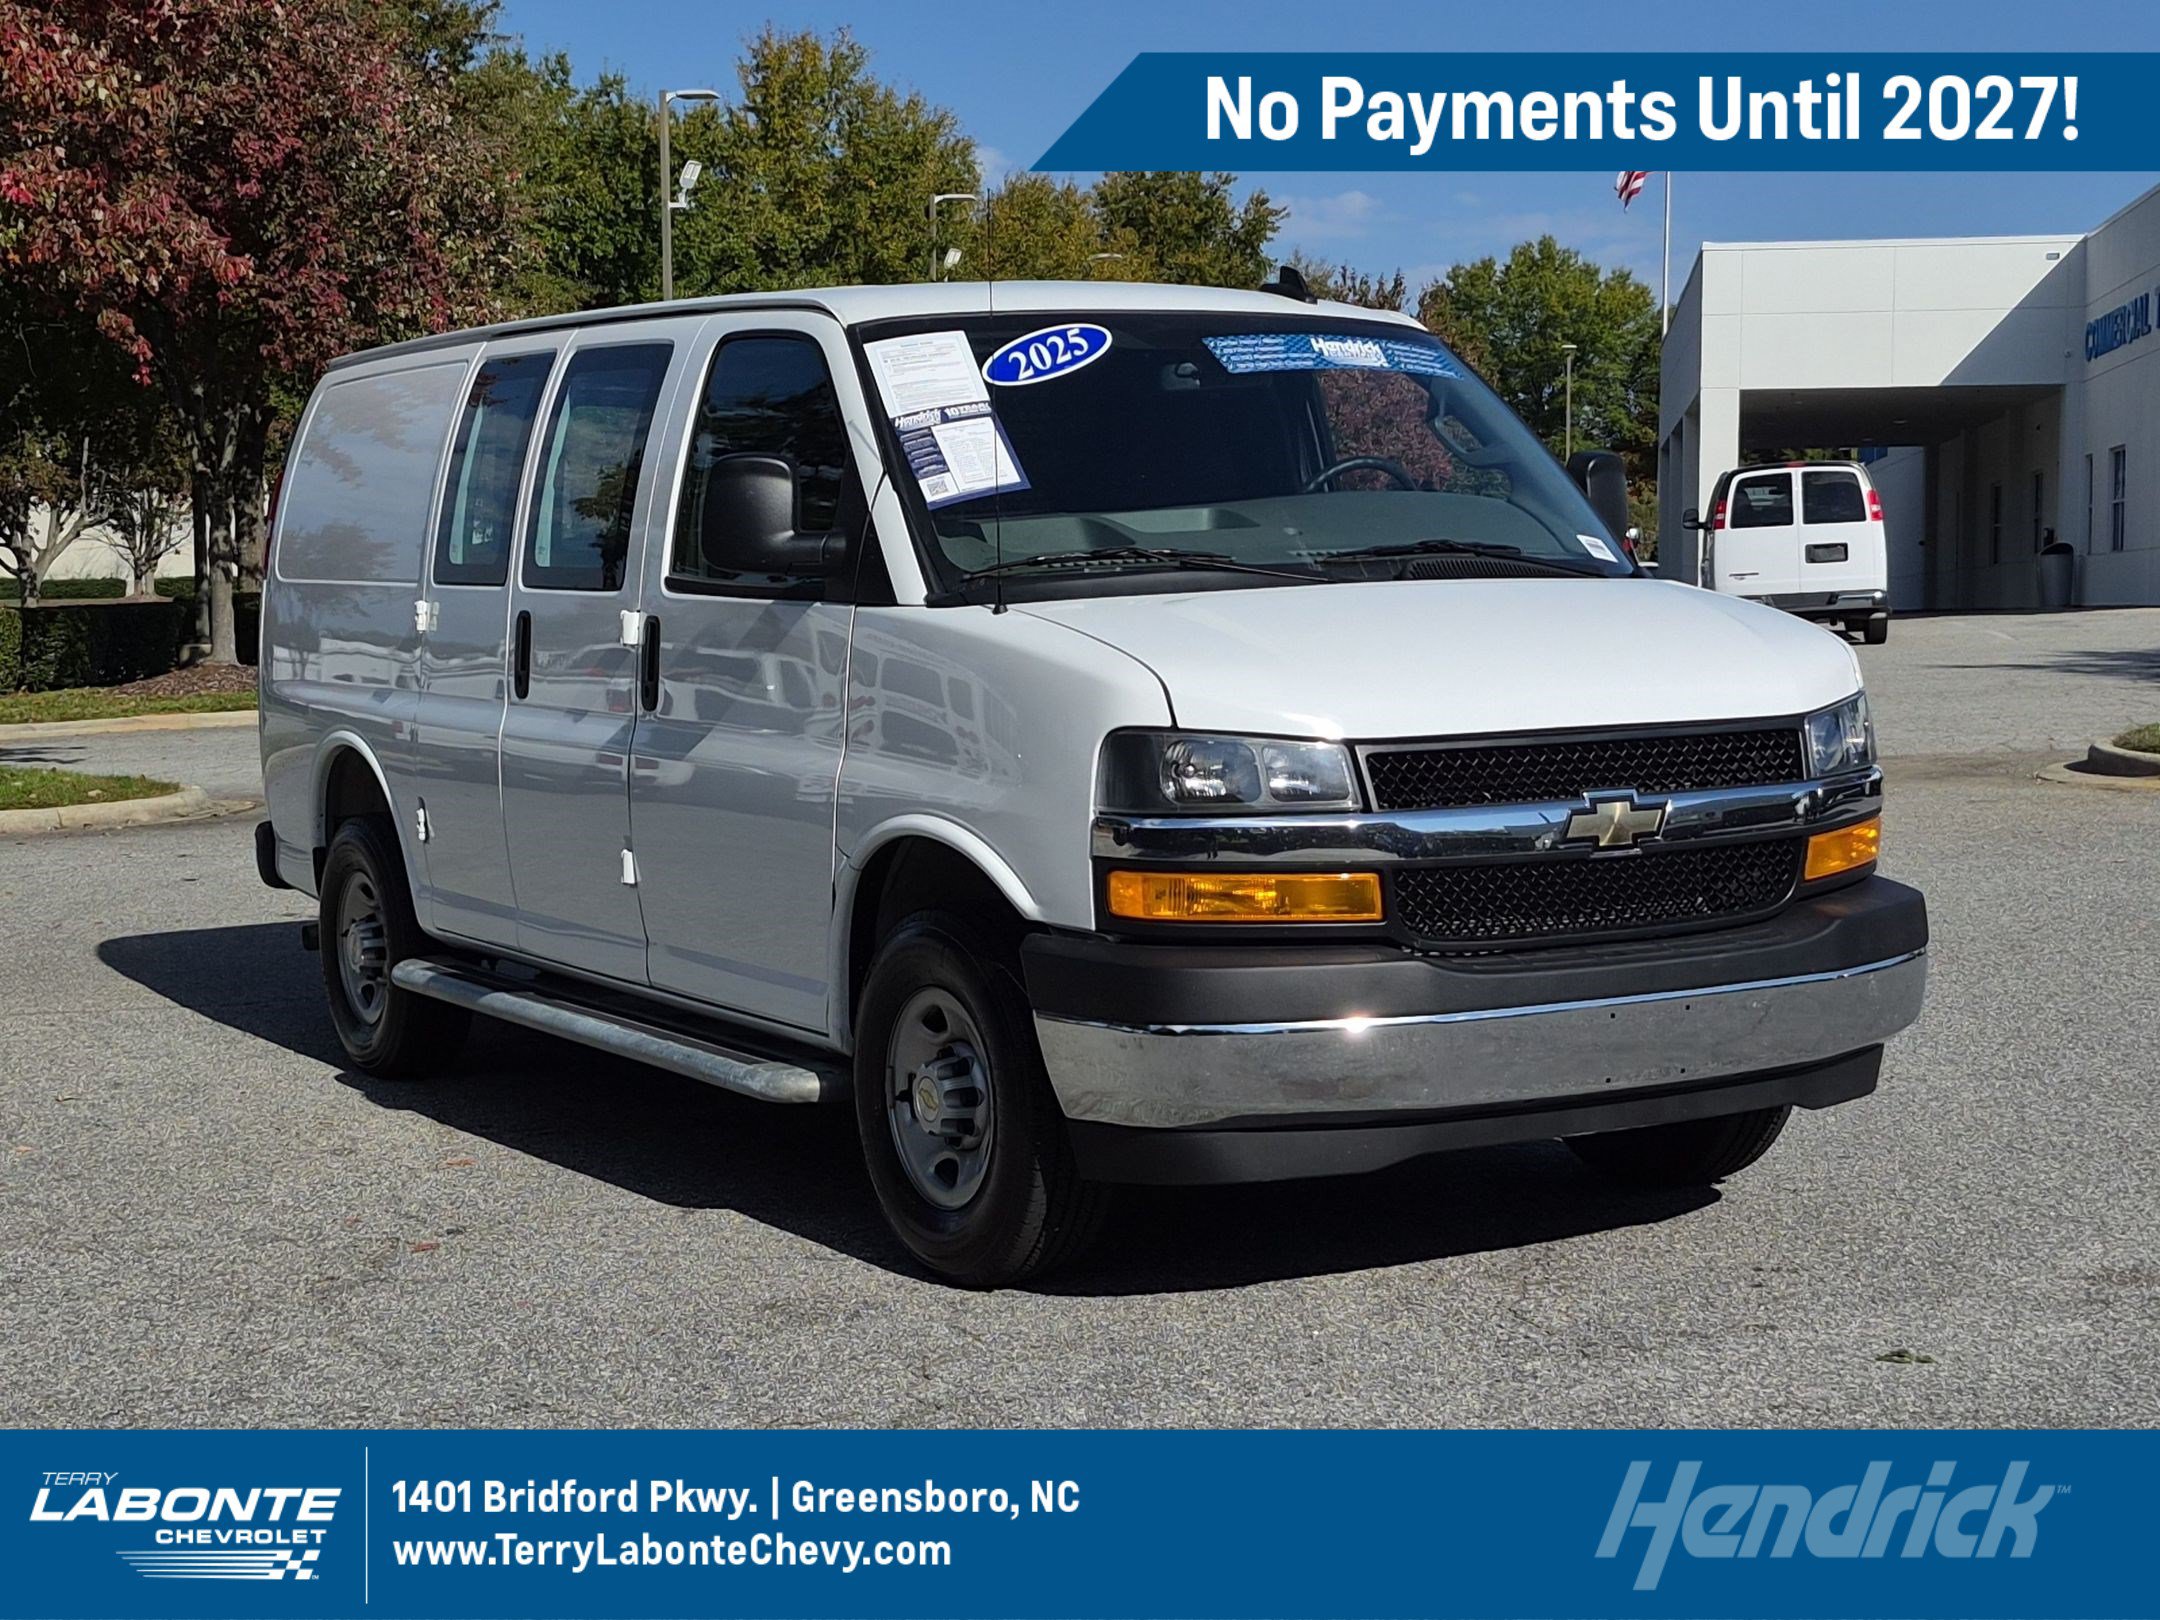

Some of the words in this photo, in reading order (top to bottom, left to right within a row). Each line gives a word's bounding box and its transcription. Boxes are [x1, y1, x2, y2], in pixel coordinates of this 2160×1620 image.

[1310, 337, 1382, 358] Hendrick
[2085, 291, 2152, 362] COMMERCIAL
[1008, 327, 1089, 381] 2025
